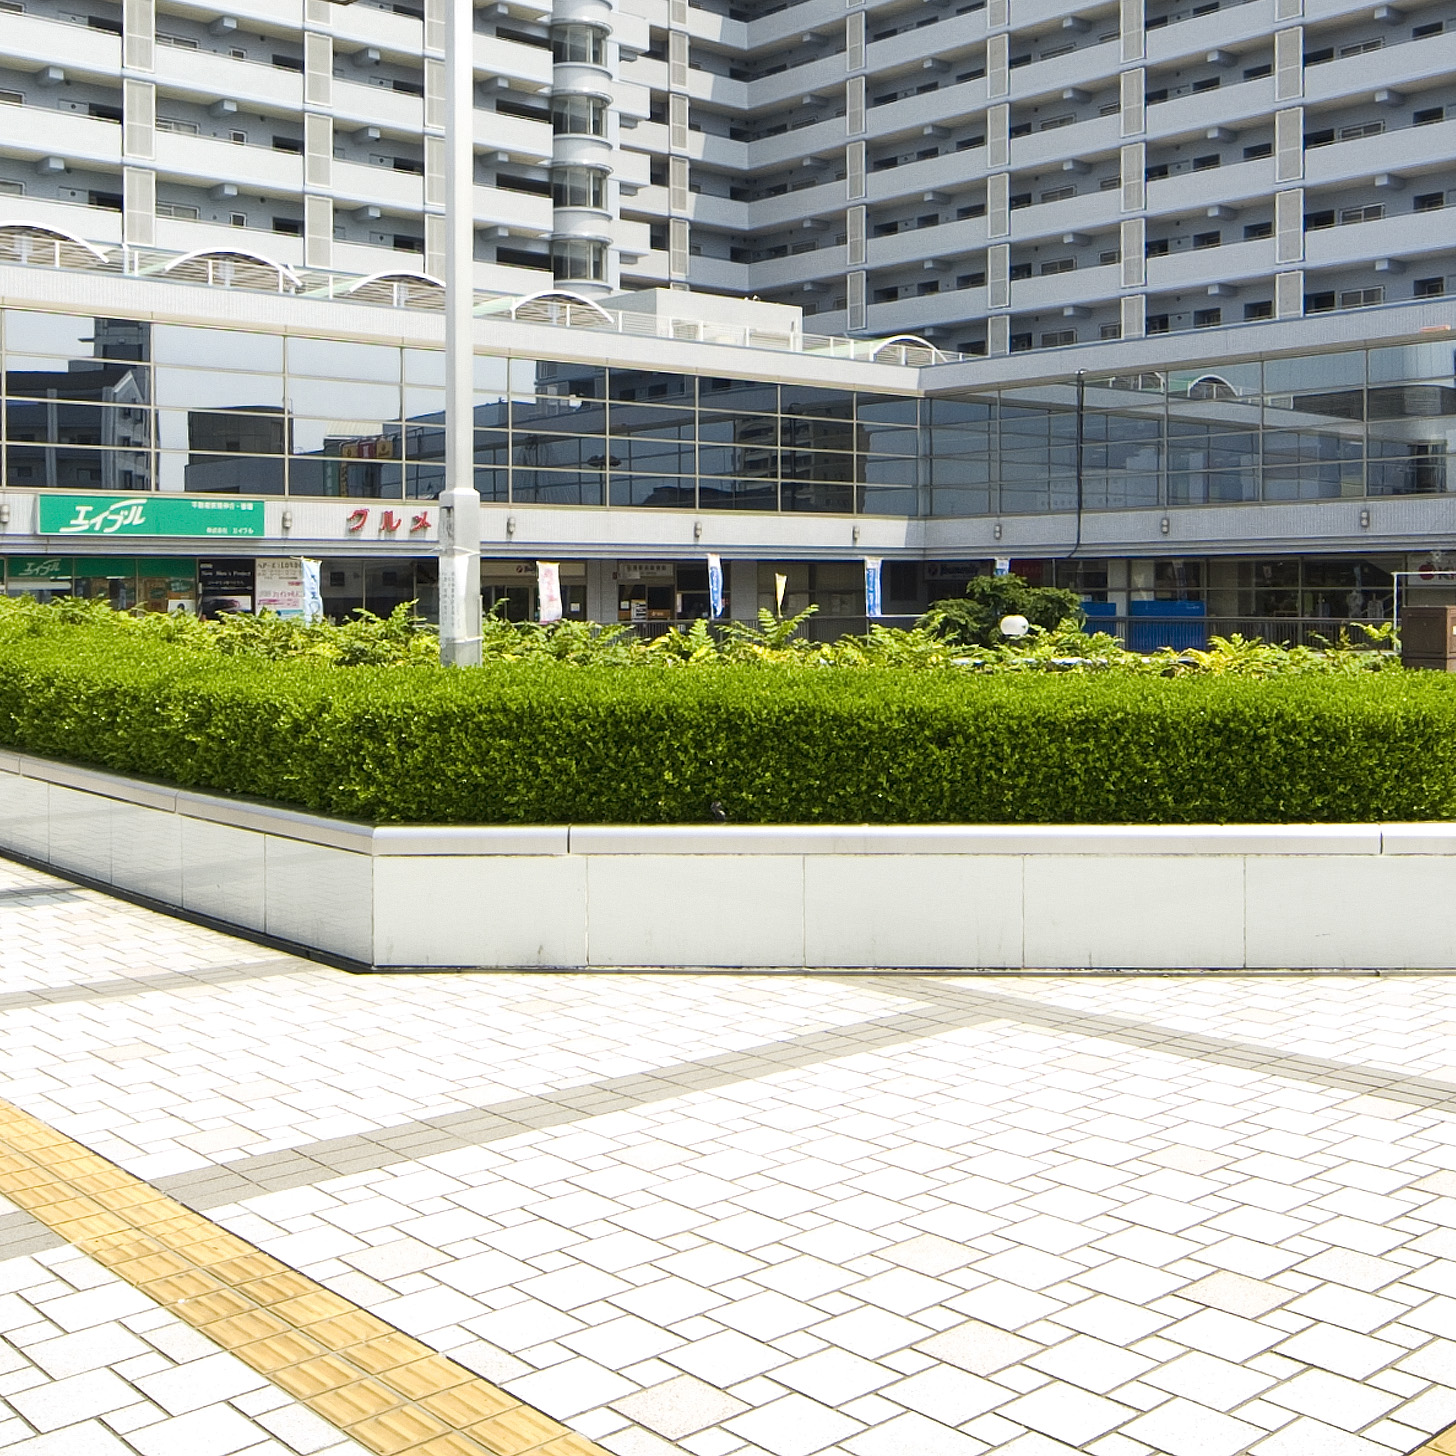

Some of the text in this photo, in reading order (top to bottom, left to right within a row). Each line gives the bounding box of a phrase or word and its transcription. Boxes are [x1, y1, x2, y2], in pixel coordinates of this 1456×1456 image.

[59, 498, 148, 533] エイブル
[348, 509, 432, 533] グルメ
